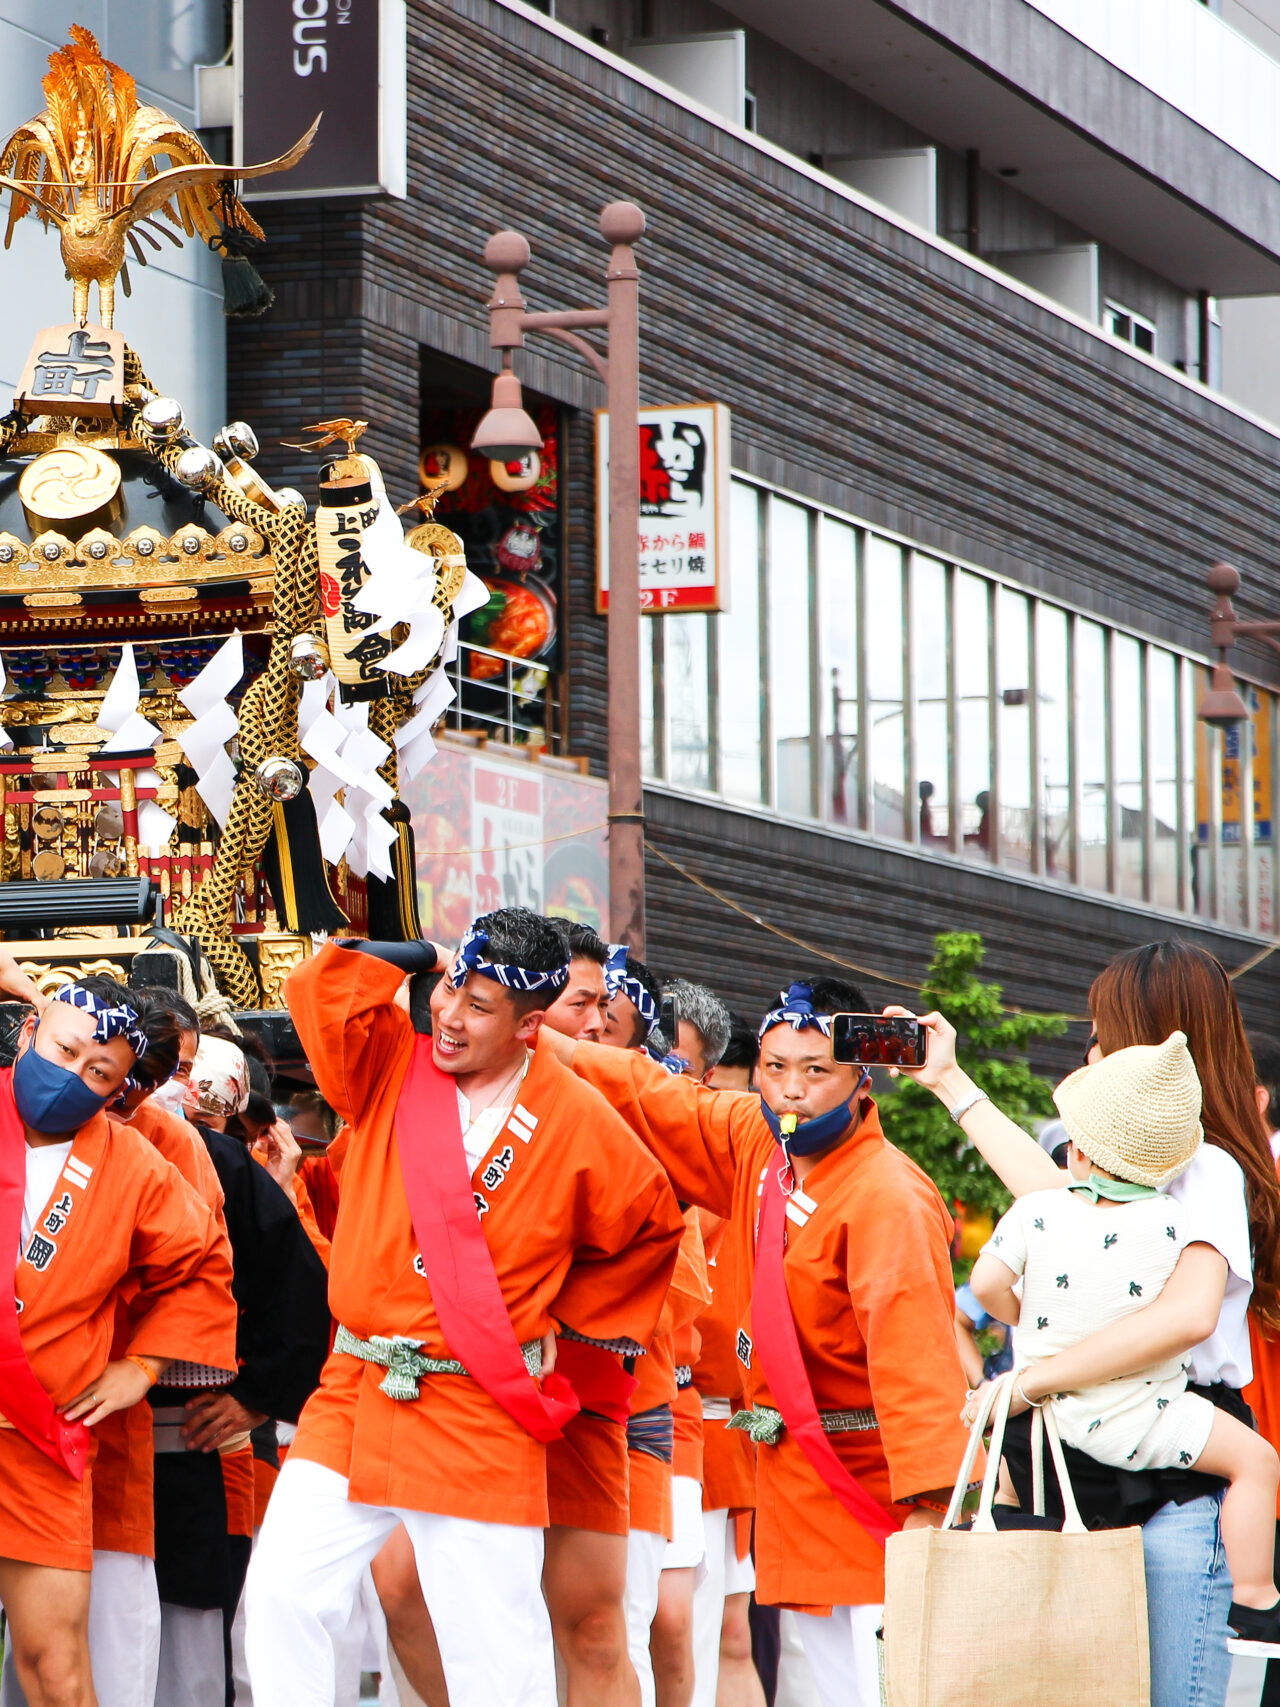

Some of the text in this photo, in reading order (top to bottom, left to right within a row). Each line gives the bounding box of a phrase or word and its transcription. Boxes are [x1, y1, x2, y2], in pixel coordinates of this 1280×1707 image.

[31, 330, 115, 400] 上町
[639, 588, 678, 608] 2F
[496, 777, 520, 807] 2F
[484, 1148, 512, 1188] 上町
[44, 1193, 71, 1233] 上町
